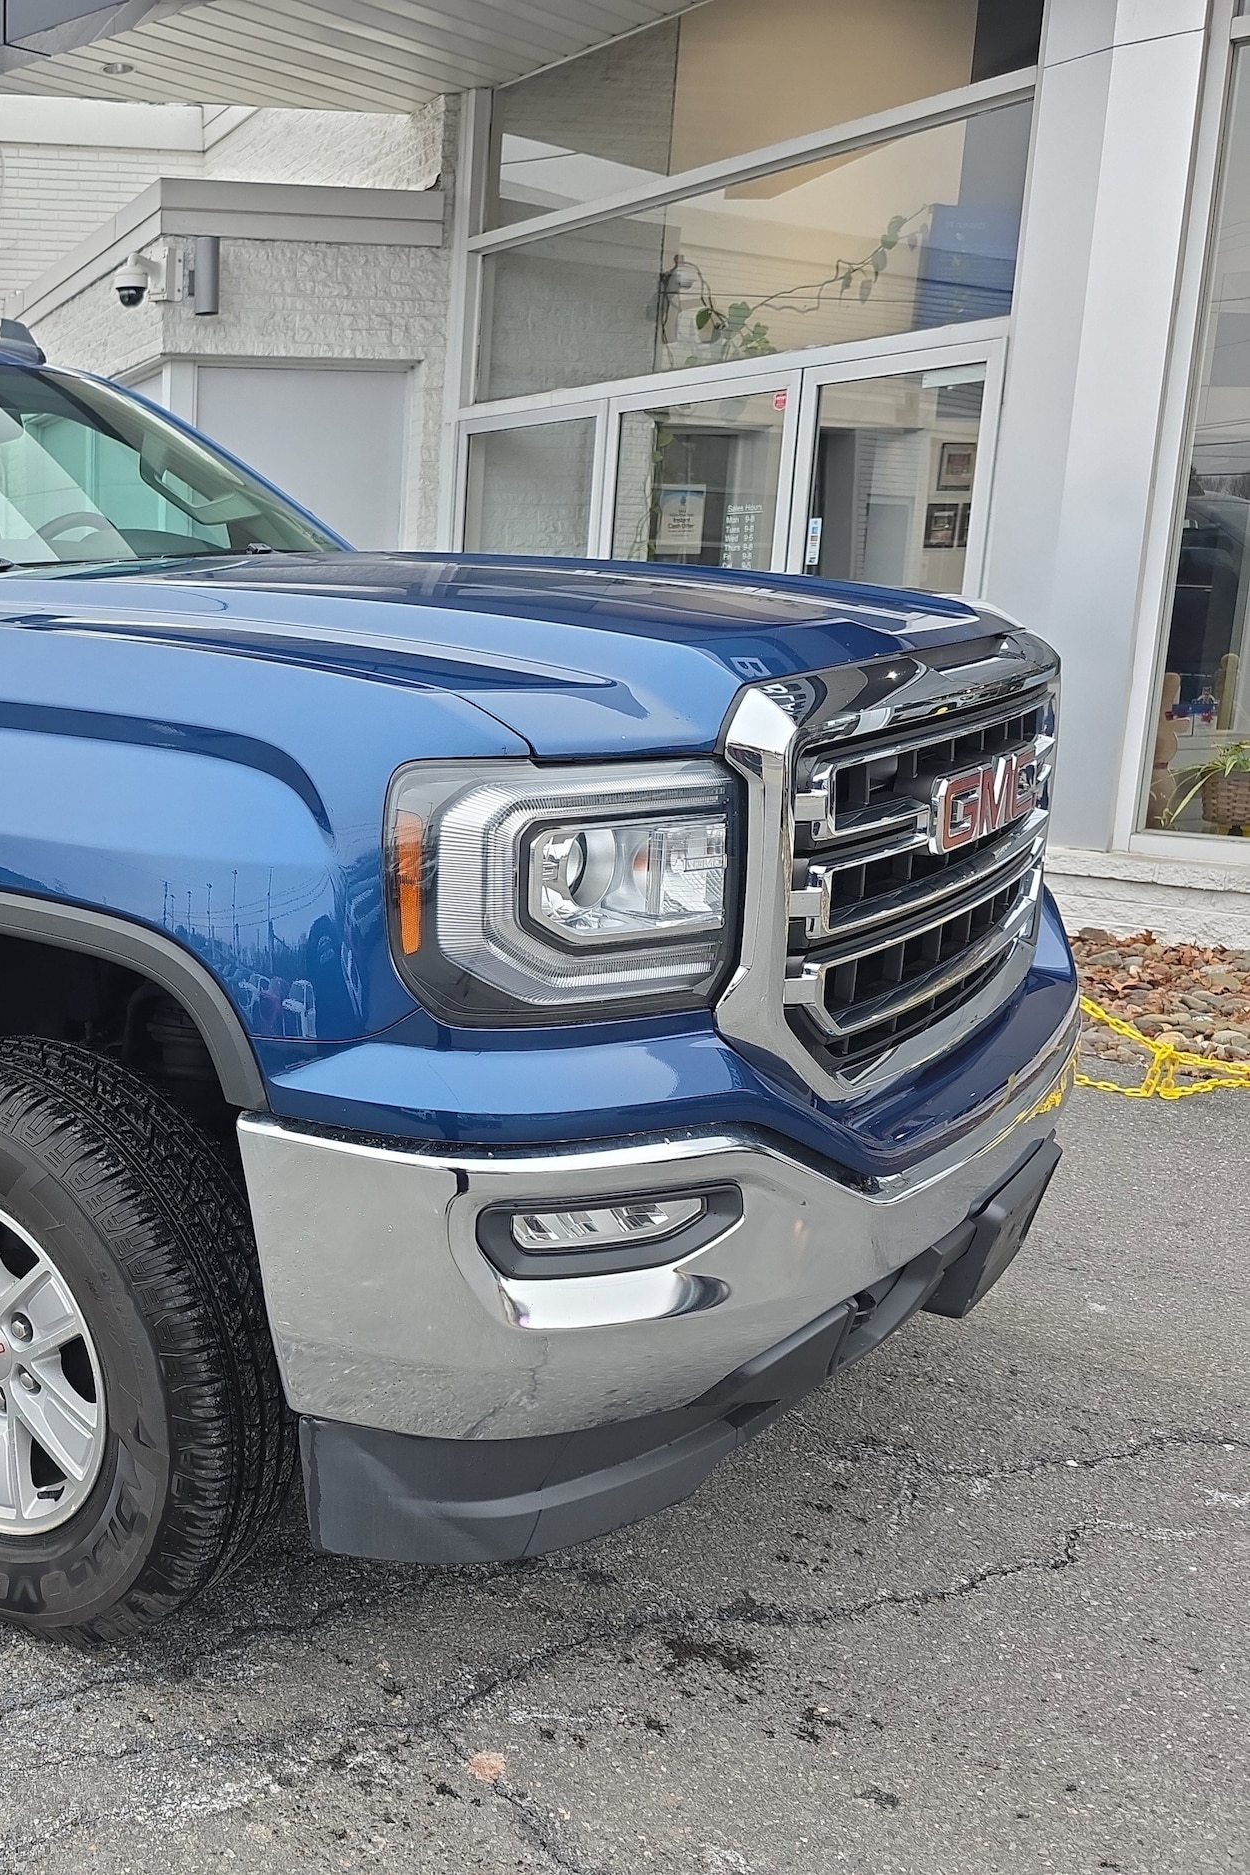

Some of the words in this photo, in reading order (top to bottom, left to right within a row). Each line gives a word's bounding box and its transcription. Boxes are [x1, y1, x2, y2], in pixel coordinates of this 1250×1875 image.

[745, 503, 763, 511] Hours
[725, 515, 740, 524] Mon
[725, 526, 740, 534] Tues
[724, 534, 739, 543] Wed
[936, 749, 1039, 854] GMC
